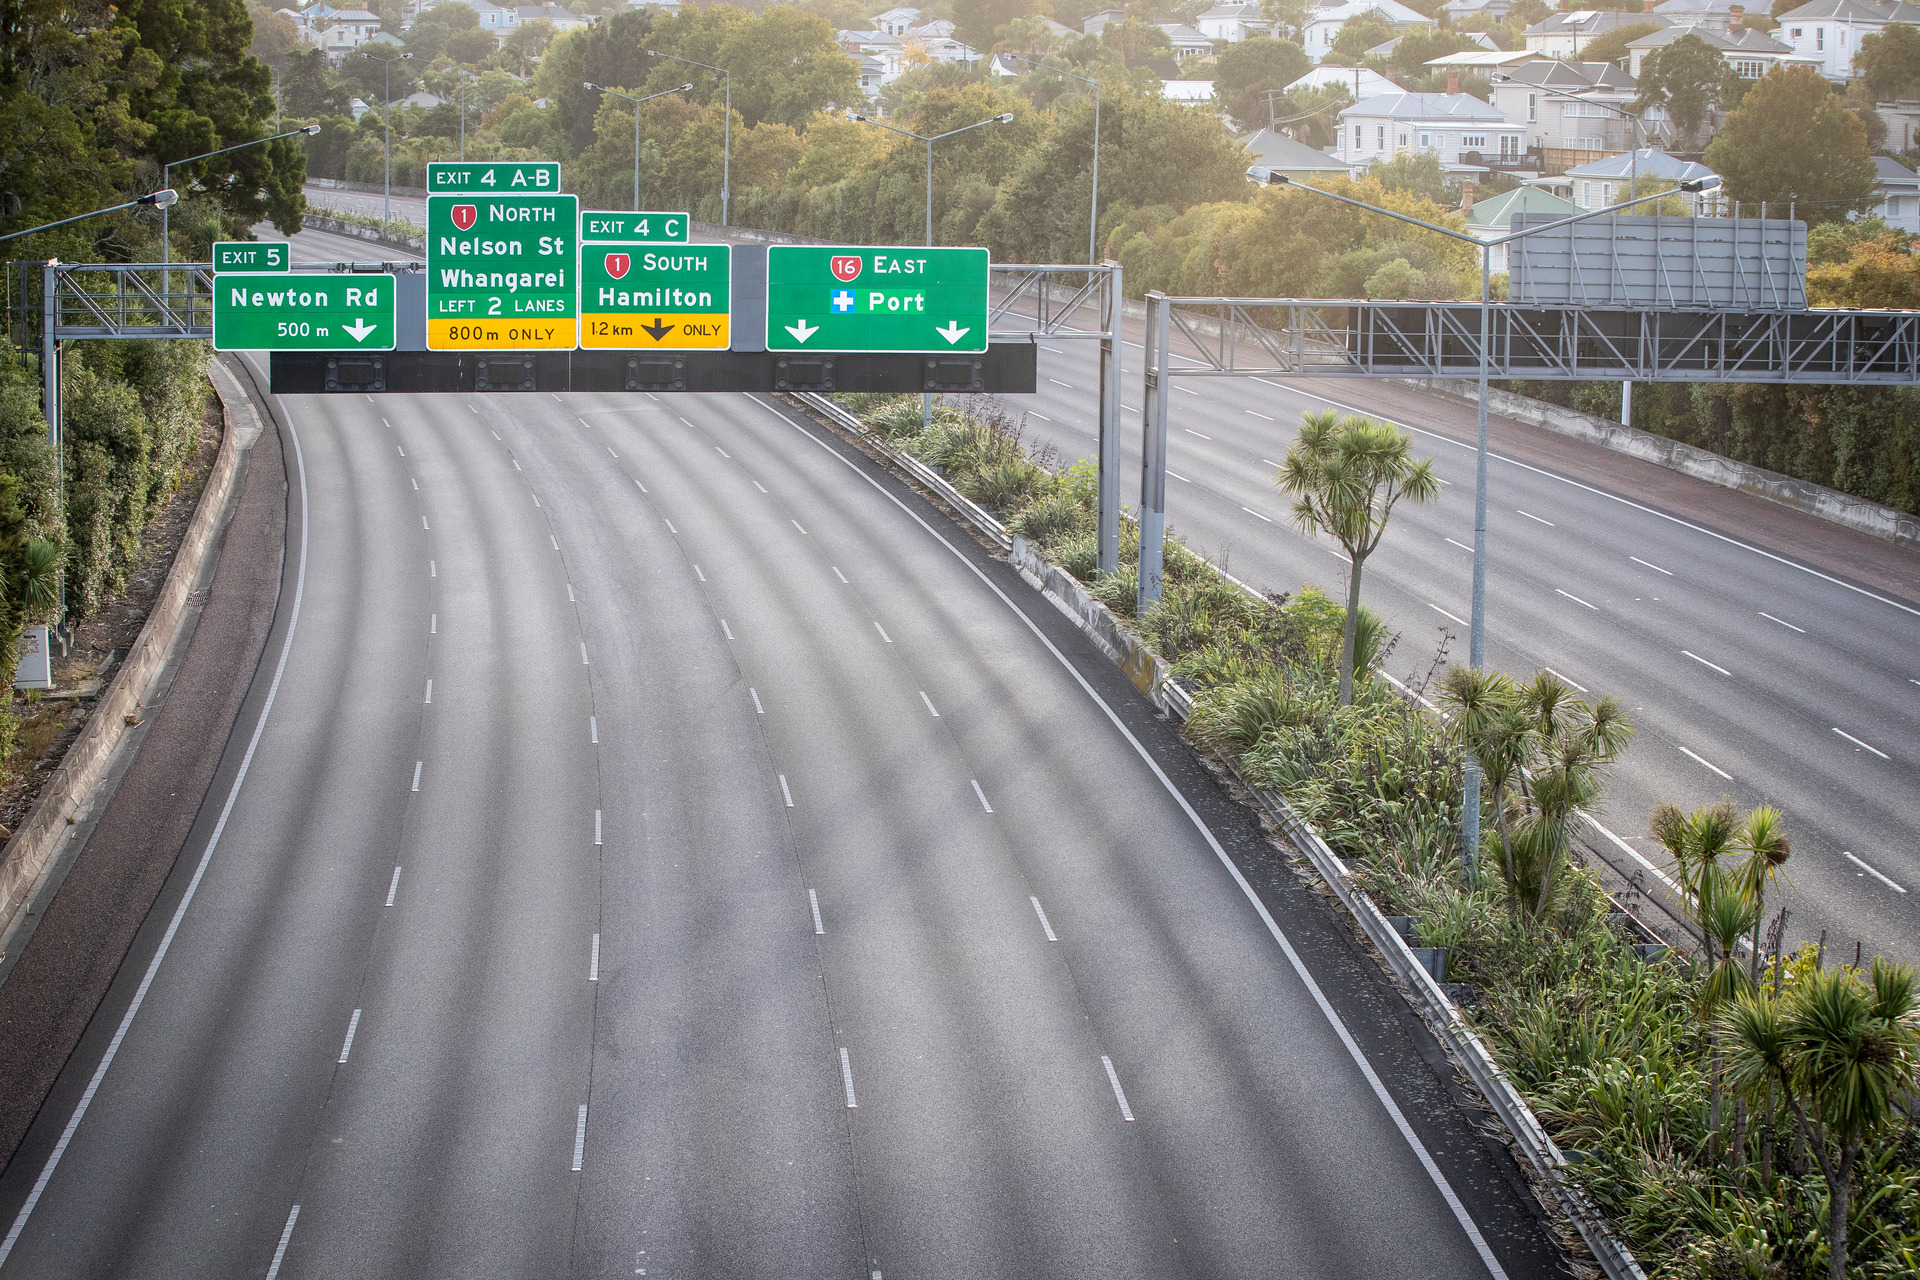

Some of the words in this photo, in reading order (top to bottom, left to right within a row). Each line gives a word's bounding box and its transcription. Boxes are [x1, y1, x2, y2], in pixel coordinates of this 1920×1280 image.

[436, 171, 472, 184] EXIT
[480, 168, 497, 187] 4
[510, 168, 550, 187] A-B
[459, 207, 469, 224] 1
[489, 203, 555, 222] NORTH
[590, 220, 625, 234] EXIT
[633, 218, 650, 237] 4
[664, 218, 679, 237] C
[440, 236, 522, 256] Nelson
[537, 236, 564, 256] St
[222, 251, 257, 264] EXIT
[266, 248, 281, 266] 5
[612, 256, 622, 273] 1
[642, 252, 707, 271] SOUTH
[834, 258, 858, 275] 16
[873, 255, 927, 274] EAST
[440, 268, 564, 294] Whangarei
[231, 287, 328, 307] Newton
[346, 287, 378, 307] Rd
[439, 299, 476, 313] LEFT
[487, 296, 502, 316] 2
[514, 299, 565, 312] LANES
[598, 287, 712, 307] Hamilton
[869, 291, 925, 312] Port
[508, 328, 555, 341] ONLY
[683, 324, 722, 336] ONLY
